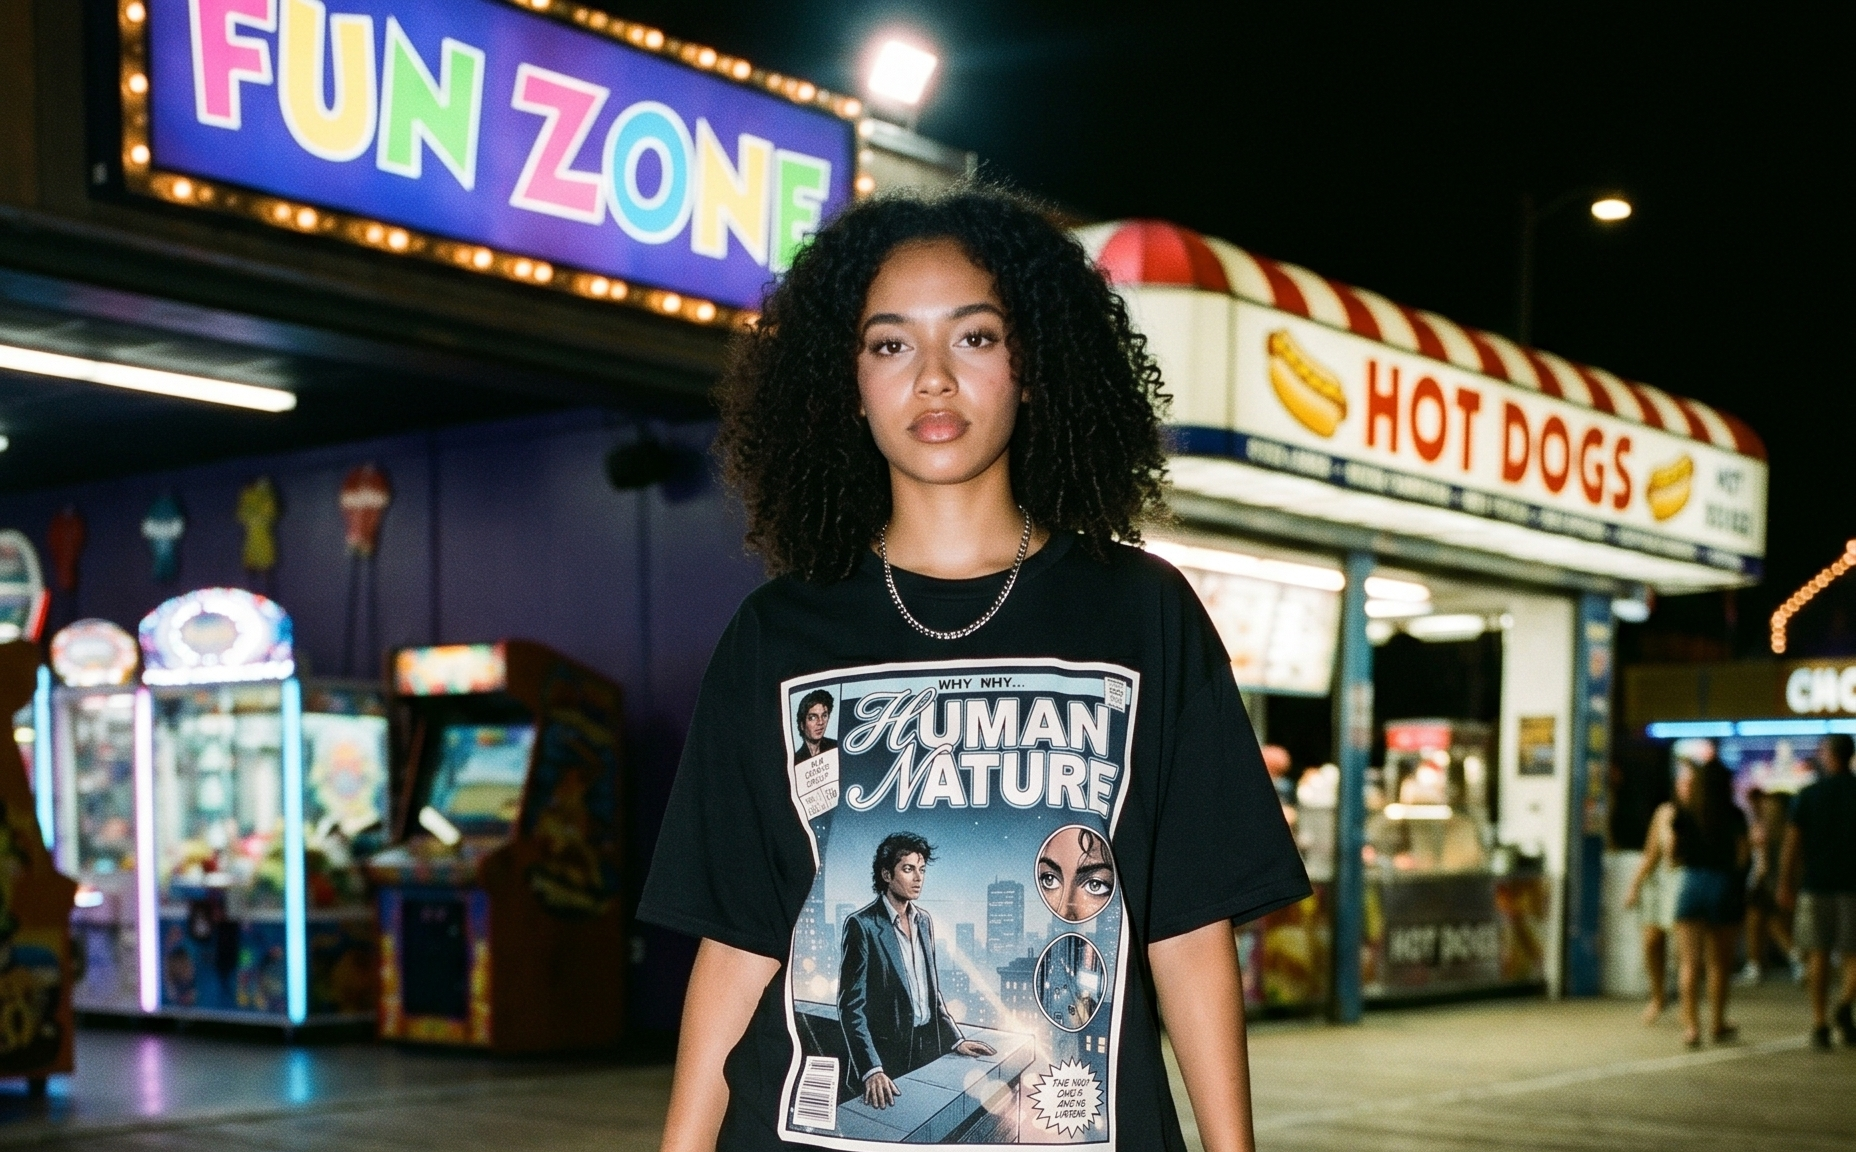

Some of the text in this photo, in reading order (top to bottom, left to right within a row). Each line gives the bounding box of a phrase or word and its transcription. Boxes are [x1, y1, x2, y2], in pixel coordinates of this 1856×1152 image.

[190, 0, 832, 274] FUN ZONE
[1366, 360, 1480, 471] HOT
[1502, 401, 1631, 510] DOGS
[844, 688, 1112, 757] HUMAN
[938, 678, 972, 690] WHY
[845, 742, 1119, 819] NATURE
